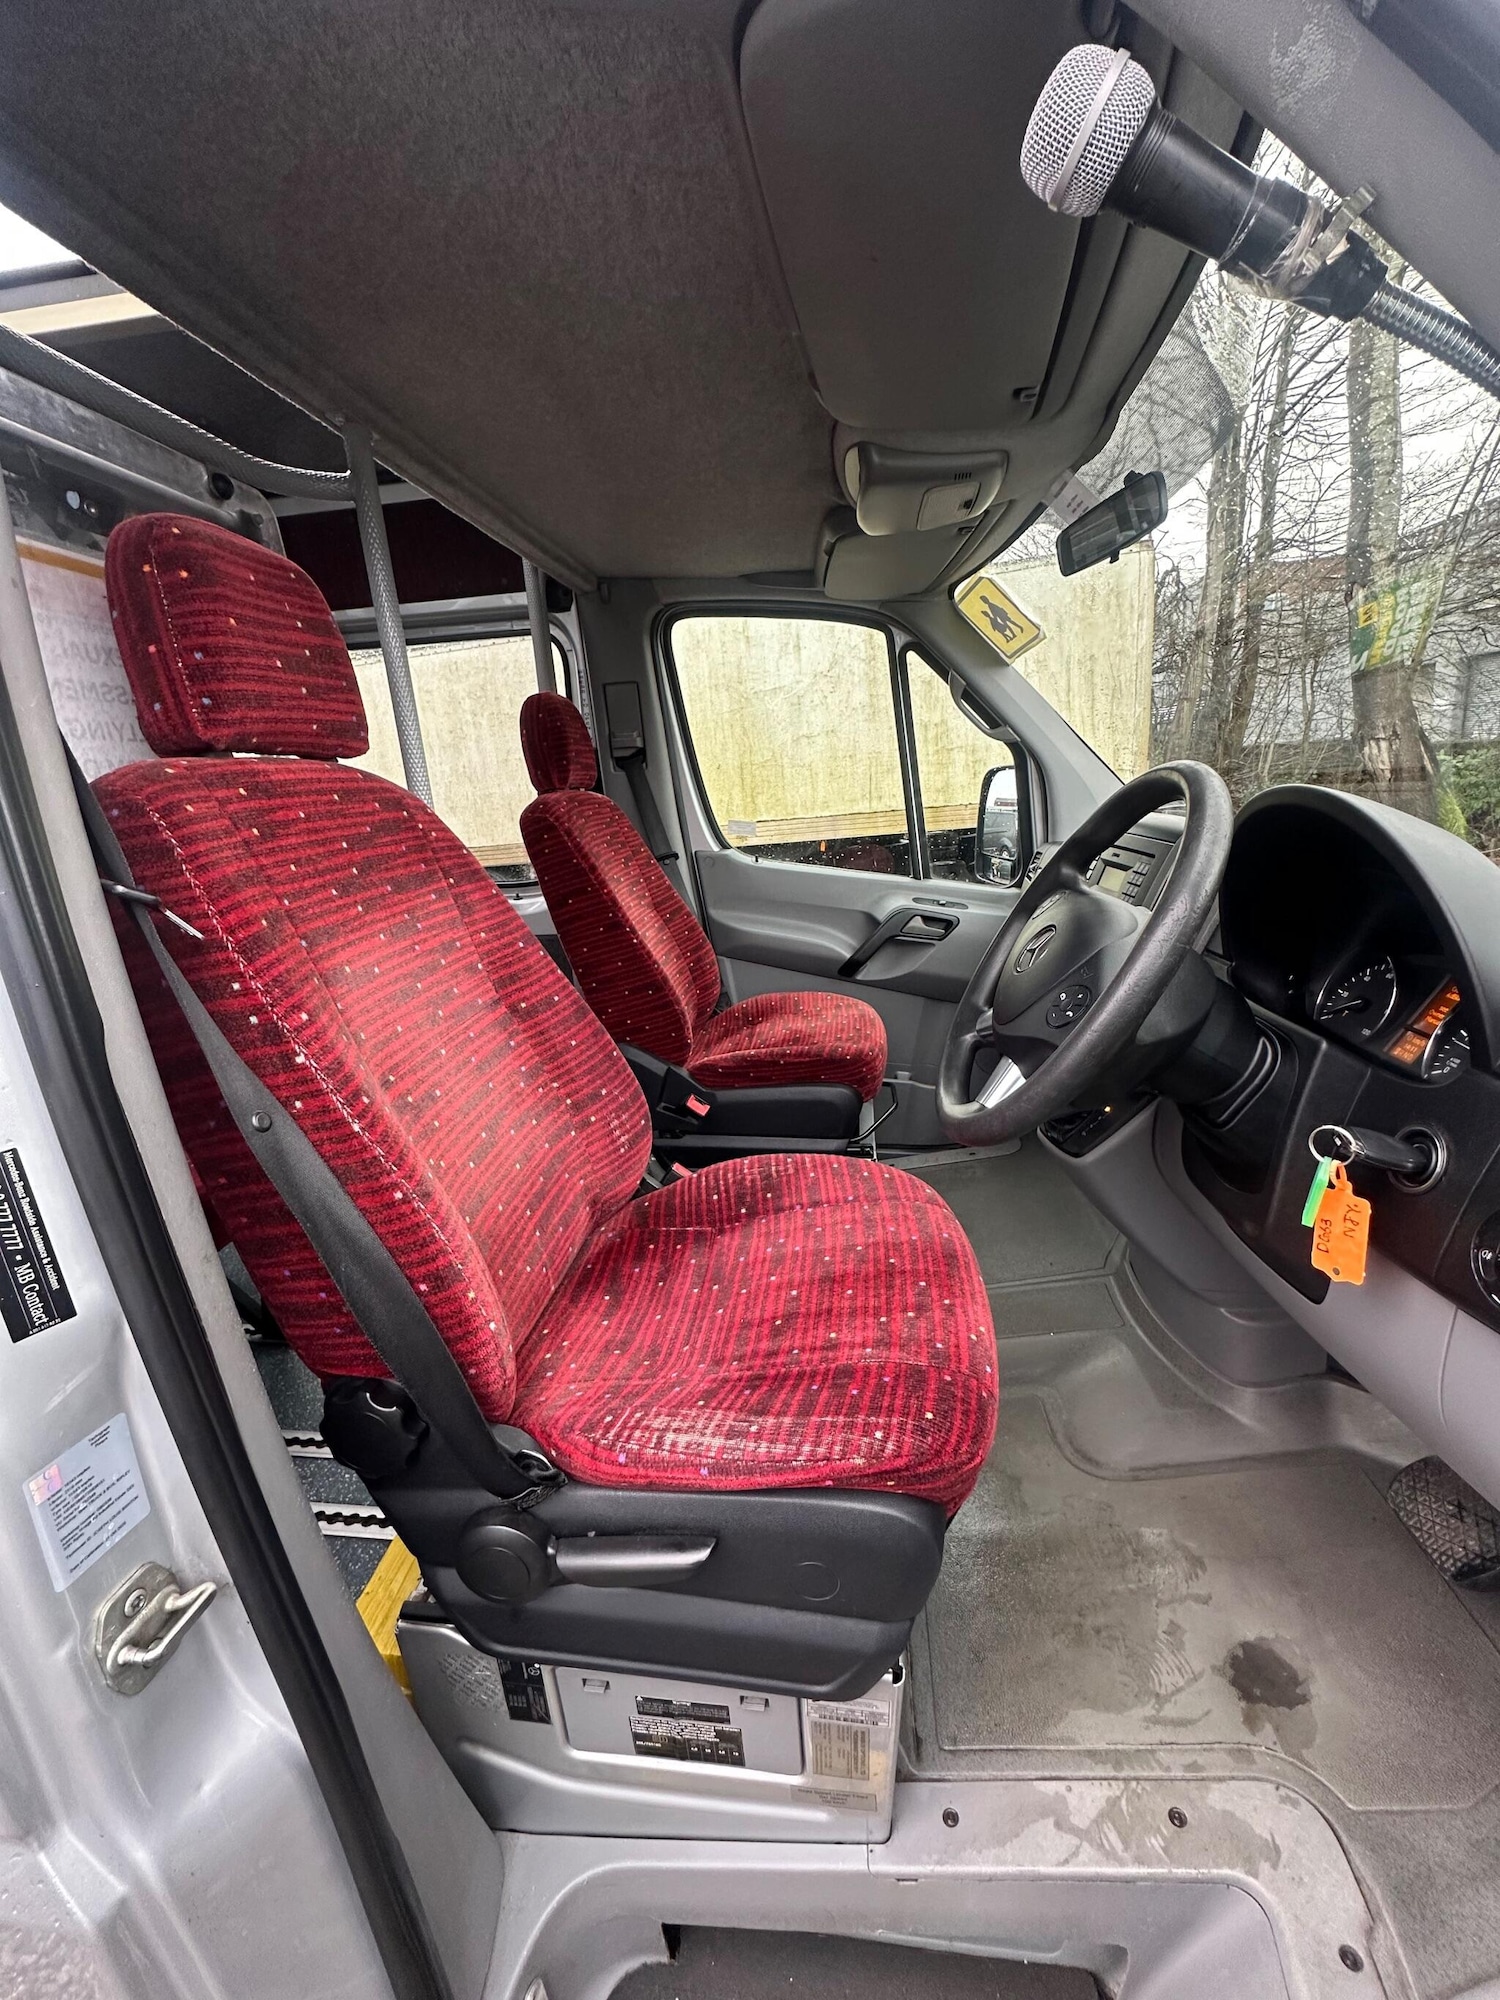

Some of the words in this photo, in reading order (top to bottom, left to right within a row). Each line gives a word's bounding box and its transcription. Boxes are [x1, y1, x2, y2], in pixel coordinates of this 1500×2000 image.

[0, 1223, 24, 1250] 7777
[3, 1151, 26, 1198] Mercedes-Benz
[20, 1197, 37, 1226] Roadside
[30, 1226, 47, 1258] Assistance
[44, 1263, 60, 1290] Accident
[14, 1262, 35, 1284] MB
[22, 1283, 49, 1326] Contact
